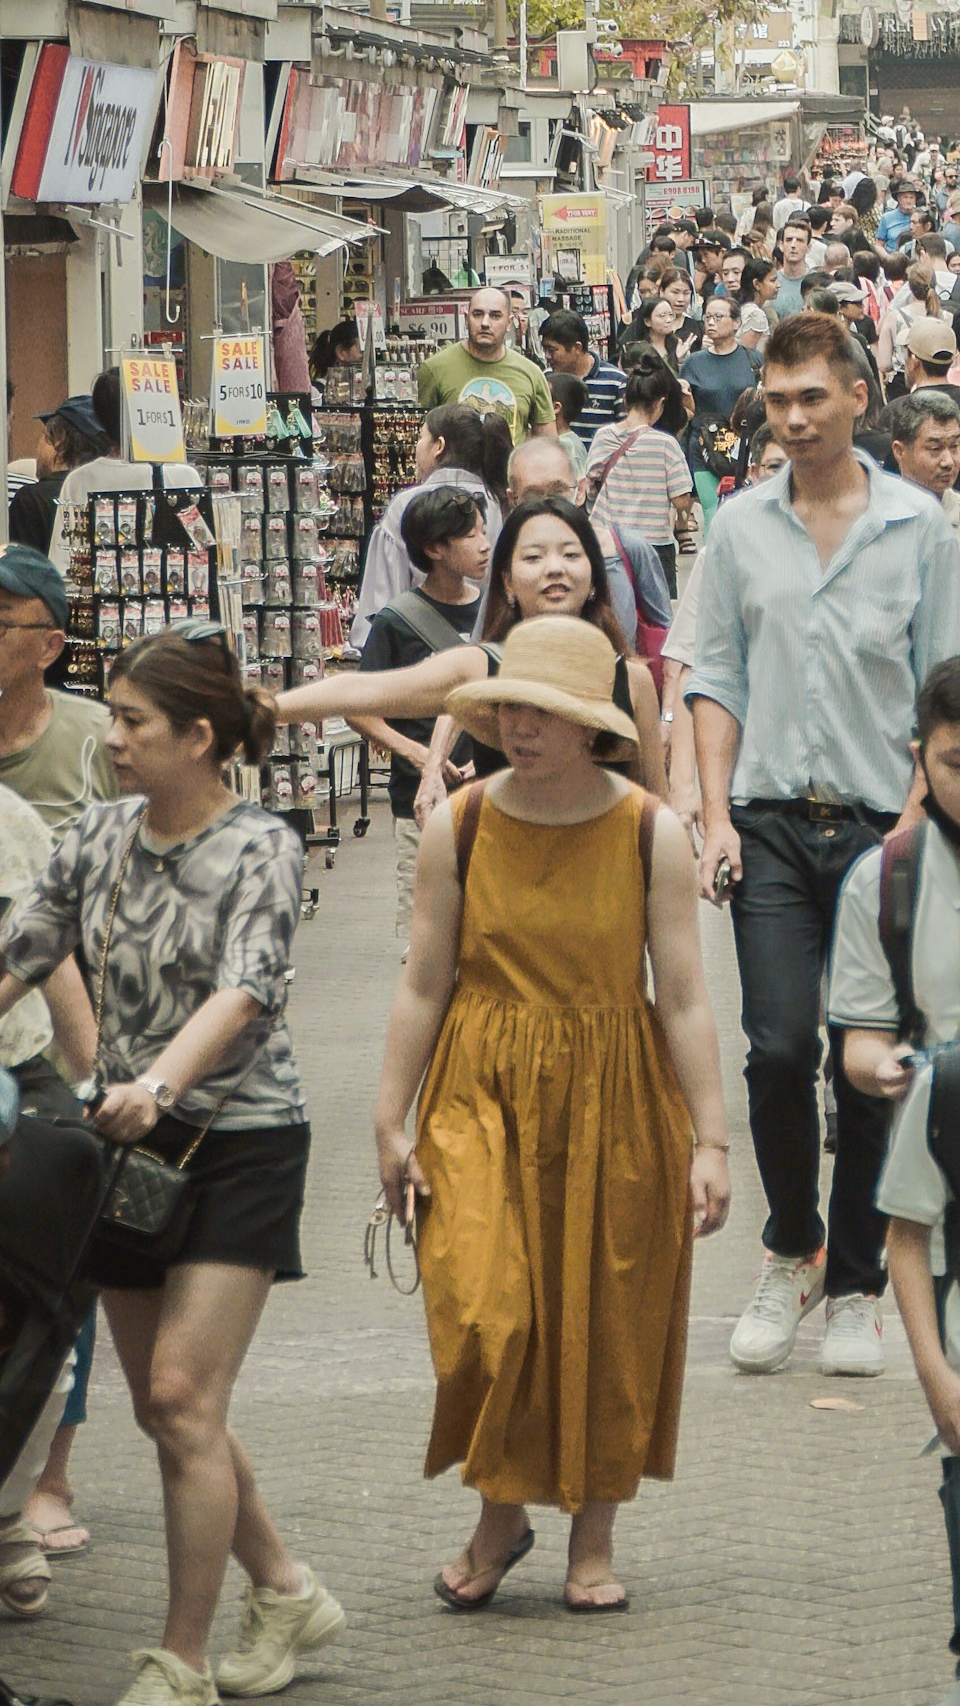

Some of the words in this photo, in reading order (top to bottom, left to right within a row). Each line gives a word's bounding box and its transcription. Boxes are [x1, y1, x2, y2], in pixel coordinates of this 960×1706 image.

[221, 342, 257, 356] SALE
[129, 361, 169, 378] SALE
[221, 356, 258, 370] SALE
[131, 378, 171, 393] SALE
